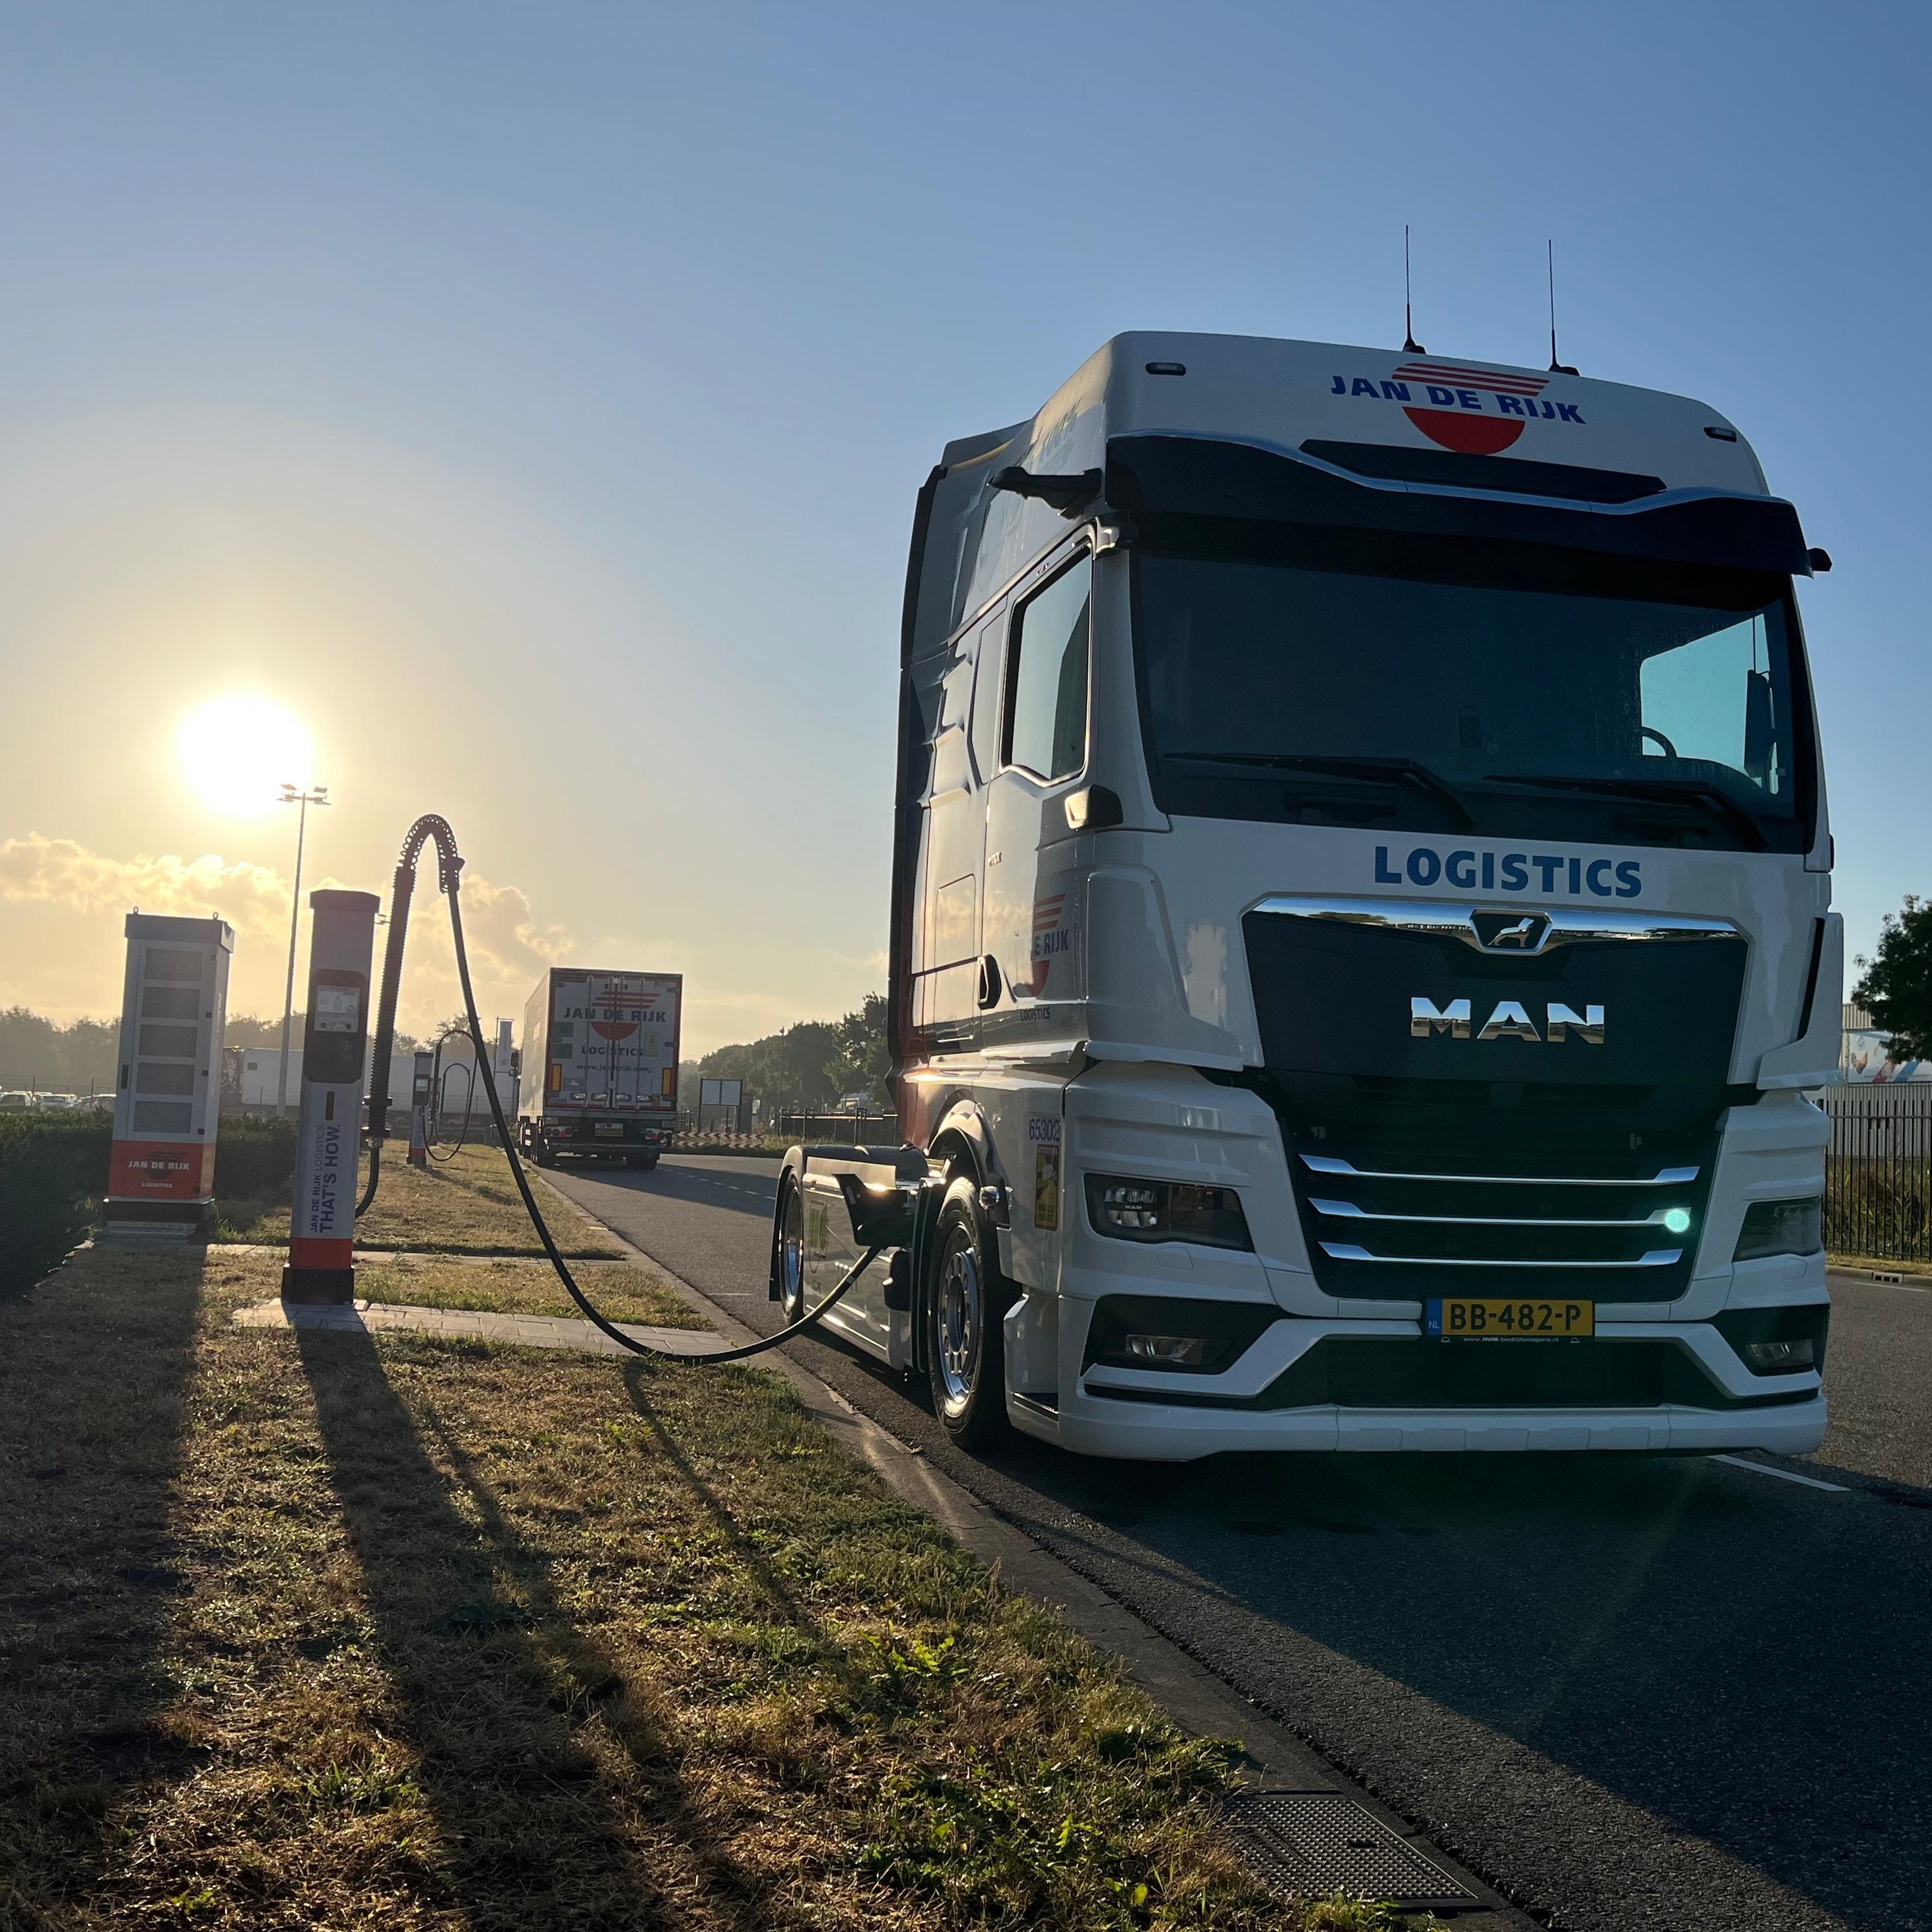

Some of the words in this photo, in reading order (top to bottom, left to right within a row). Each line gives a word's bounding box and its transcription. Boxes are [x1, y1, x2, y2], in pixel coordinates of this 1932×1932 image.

[1330, 375, 1412, 401] JAN
[1426, 385, 1482, 410] DE
[1494, 394, 1587, 425] RIJK
[1374, 846, 1642, 899] LOGISTICS
[1044, 929, 1069, 955] RIJK
[564, 1007, 596, 1019] JAN
[603, 1009, 624, 1021] DE
[631, 1010, 667, 1023] RIJK
[1019, 1006, 1051, 1021] LOGISTICS
[1410, 997, 1604, 1045] MAN
[581, 1046, 644, 1056] LOGISTICS
[1029, 1118, 1060, 1142] 65302
[314, 1124, 325, 1172] LOGISTICS
[324, 1124, 341, 1167] HOW.
[127, 1160, 147, 1169] JAN
[151, 1161, 164, 1169] DE
[312, 1174, 322, 1195] RIJK
[312, 1198, 320, 1212] DE
[310, 1214, 319, 1233] JAN
[1451, 1303, 1581, 1331] BB-482-P
